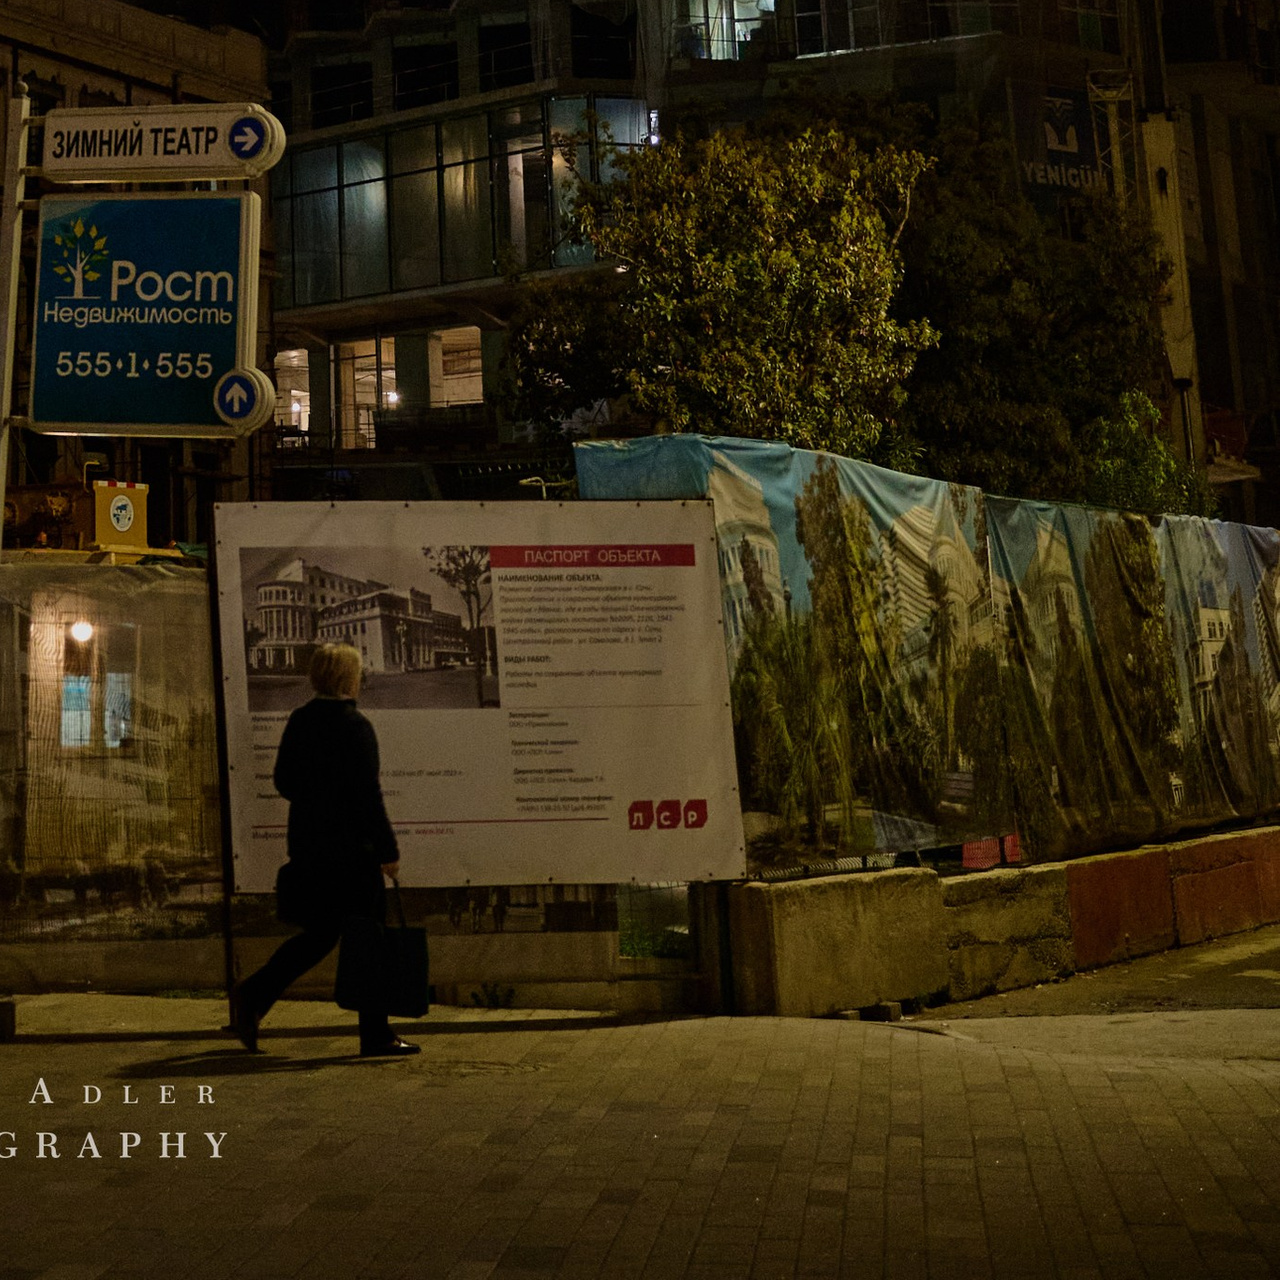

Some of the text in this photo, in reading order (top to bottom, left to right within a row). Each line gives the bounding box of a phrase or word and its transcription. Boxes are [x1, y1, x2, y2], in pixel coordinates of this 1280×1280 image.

[52, 120, 218, 159] ЗИМНИЙ ТЕАТР
[110, 259, 234, 302] Рост
[43, 301, 233, 329] Недвижимость
[524, 548, 662, 563] ПАСПОРТ ОБЪЕКТА
[497, 574, 564, 582] НАИМЕНОВАНИЕ
